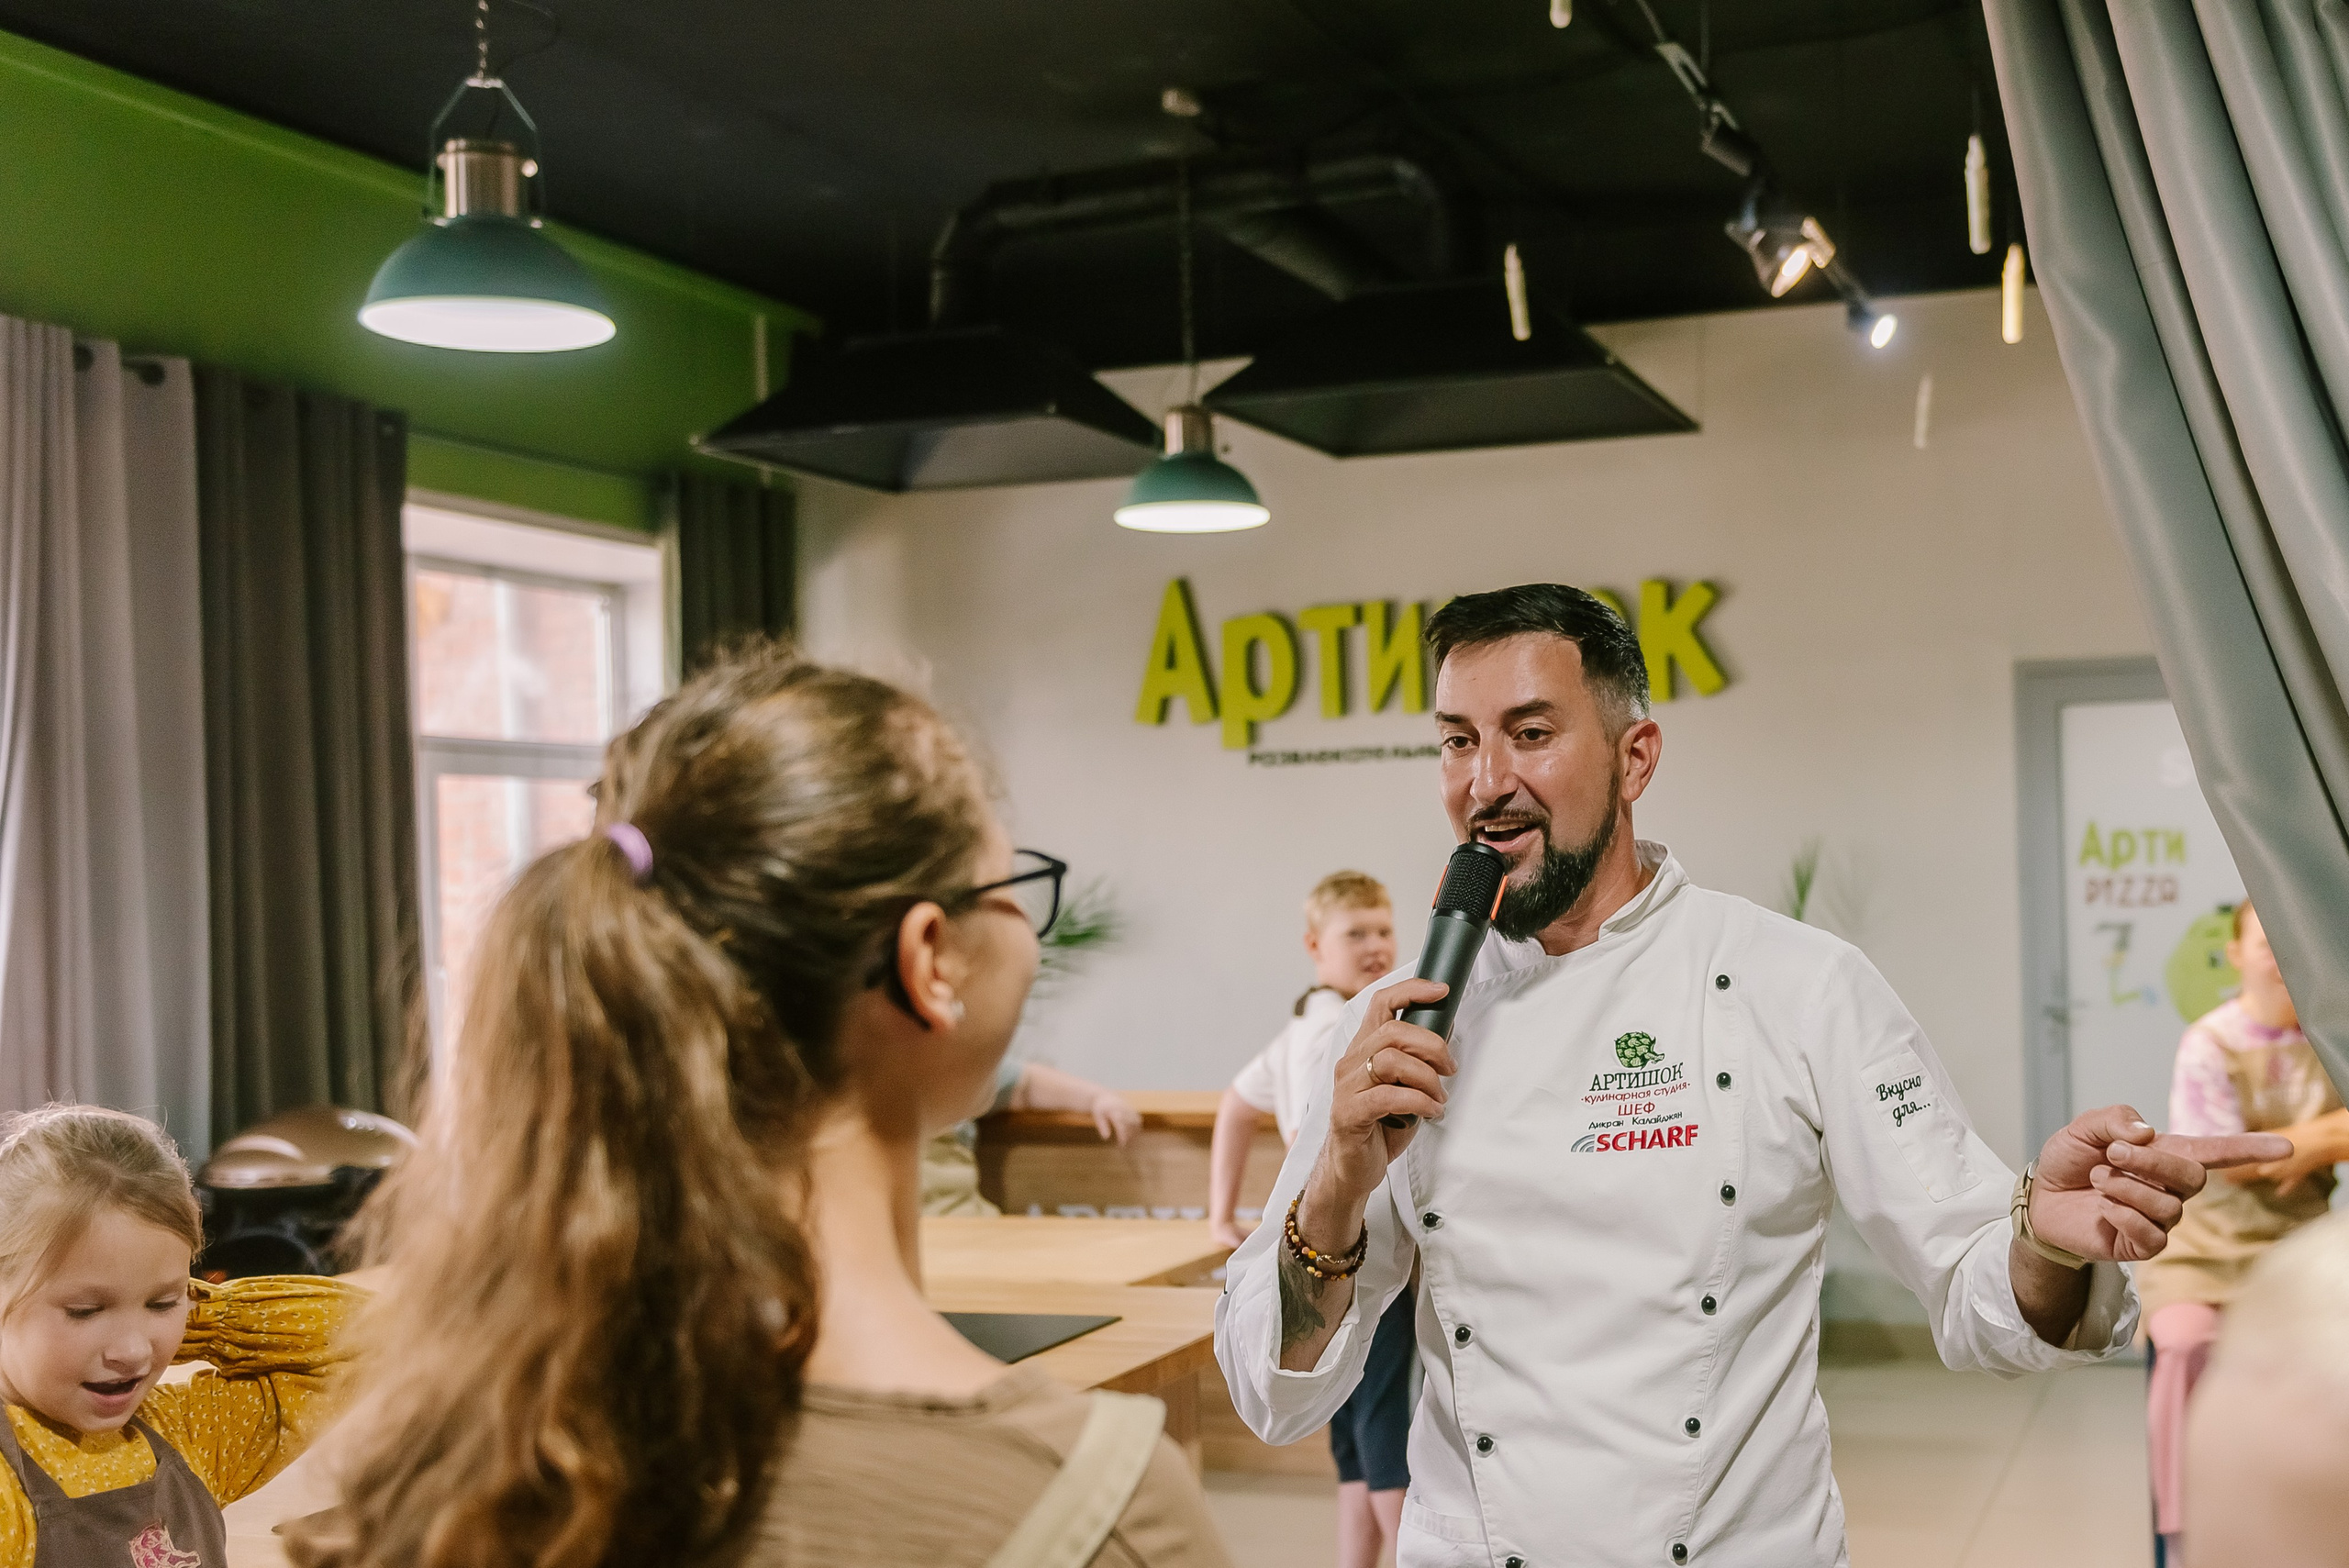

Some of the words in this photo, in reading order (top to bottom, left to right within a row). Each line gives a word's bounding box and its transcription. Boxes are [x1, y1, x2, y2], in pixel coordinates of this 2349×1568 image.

[1135, 576, 1730, 749] Артик
[1588, 1062, 1684, 1092] АРТИШОК
[1876, 1075, 1921, 1101] Вкусно
[1588, 1118, 1624, 1130] Дикран
[1631, 1111, 1683, 1126] Калайджян
[1618, 1101, 1655, 1117] ШЕФ
[1596, 1124, 1699, 1152] SCHARF
